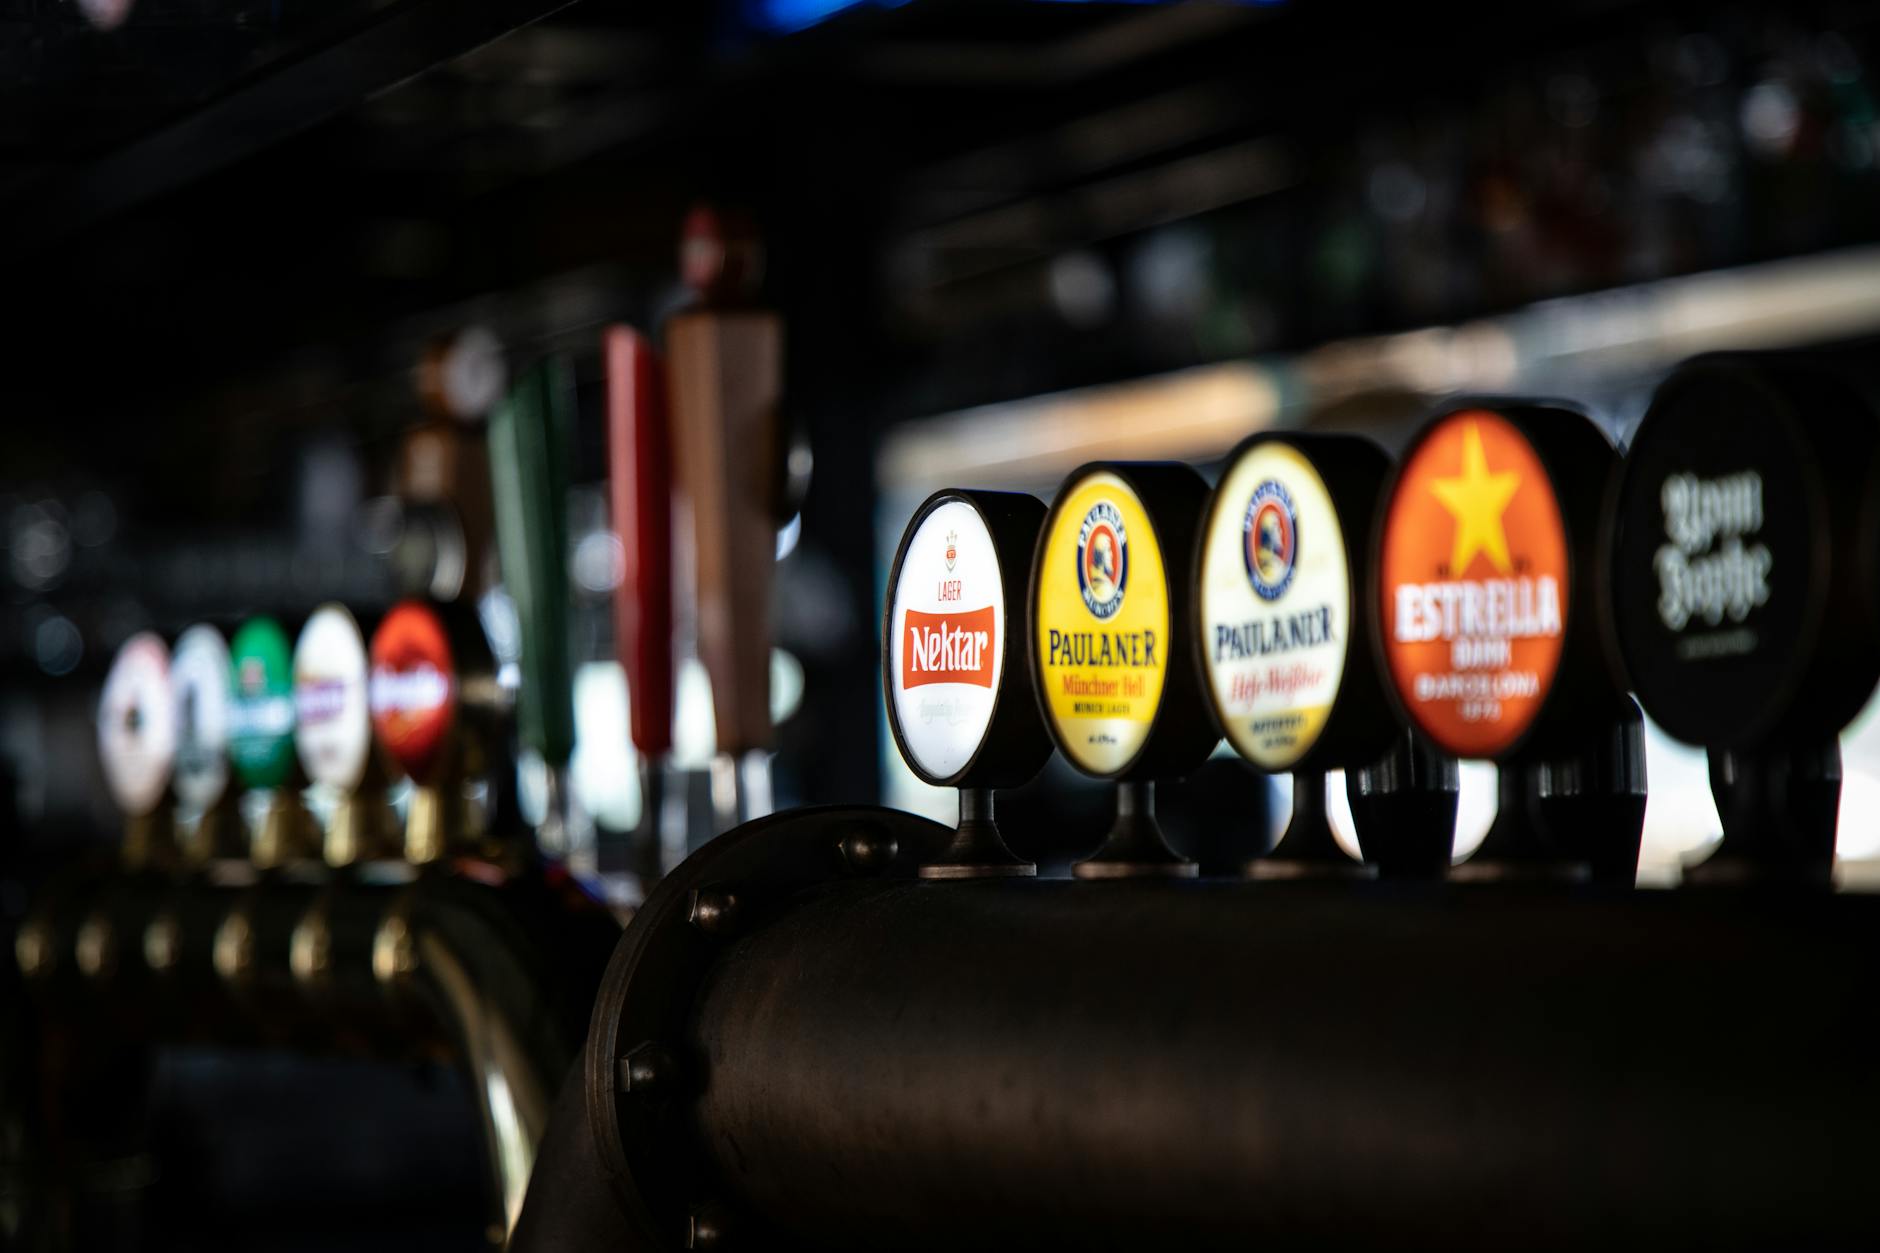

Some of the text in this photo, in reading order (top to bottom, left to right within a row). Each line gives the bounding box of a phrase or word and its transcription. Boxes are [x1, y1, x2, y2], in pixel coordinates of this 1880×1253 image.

[938, 580, 962, 602] LAGER
[1395, 574, 1562, 642] ESTRELLA
[911, 620, 988, 672] Nektar
[1048, 629, 1157, 667] PAULANER
[1214, 606, 1334, 661] PAULANER
[1063, 673, 1146, 697] Münchner Hell
